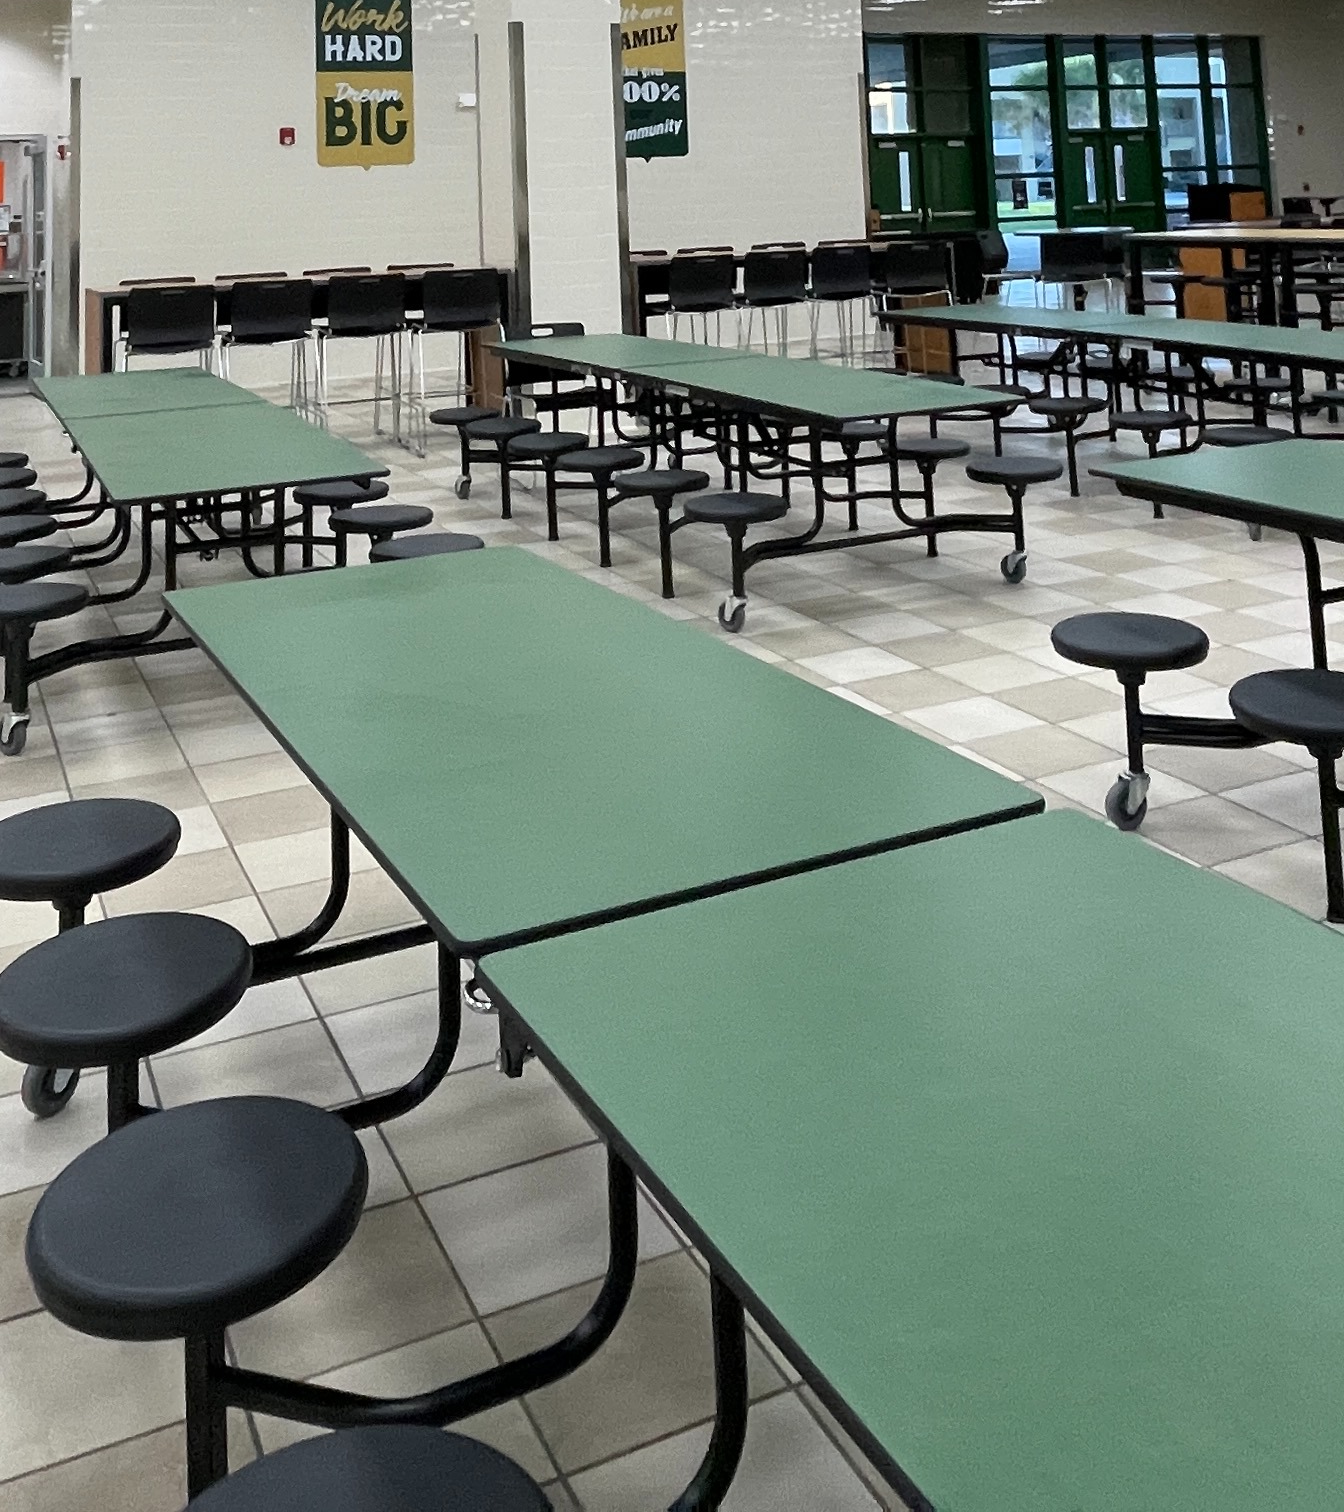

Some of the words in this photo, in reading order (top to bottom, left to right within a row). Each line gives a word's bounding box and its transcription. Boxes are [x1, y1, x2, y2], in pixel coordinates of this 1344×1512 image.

[324, 35, 403, 62] HARD
[621, 23, 678, 50] AMILY
[334, 82, 402, 102] Dream
[623, 81, 681, 103] 00%
[324, 95, 409, 147] BIG
[625, 118, 682, 140] mmunity
